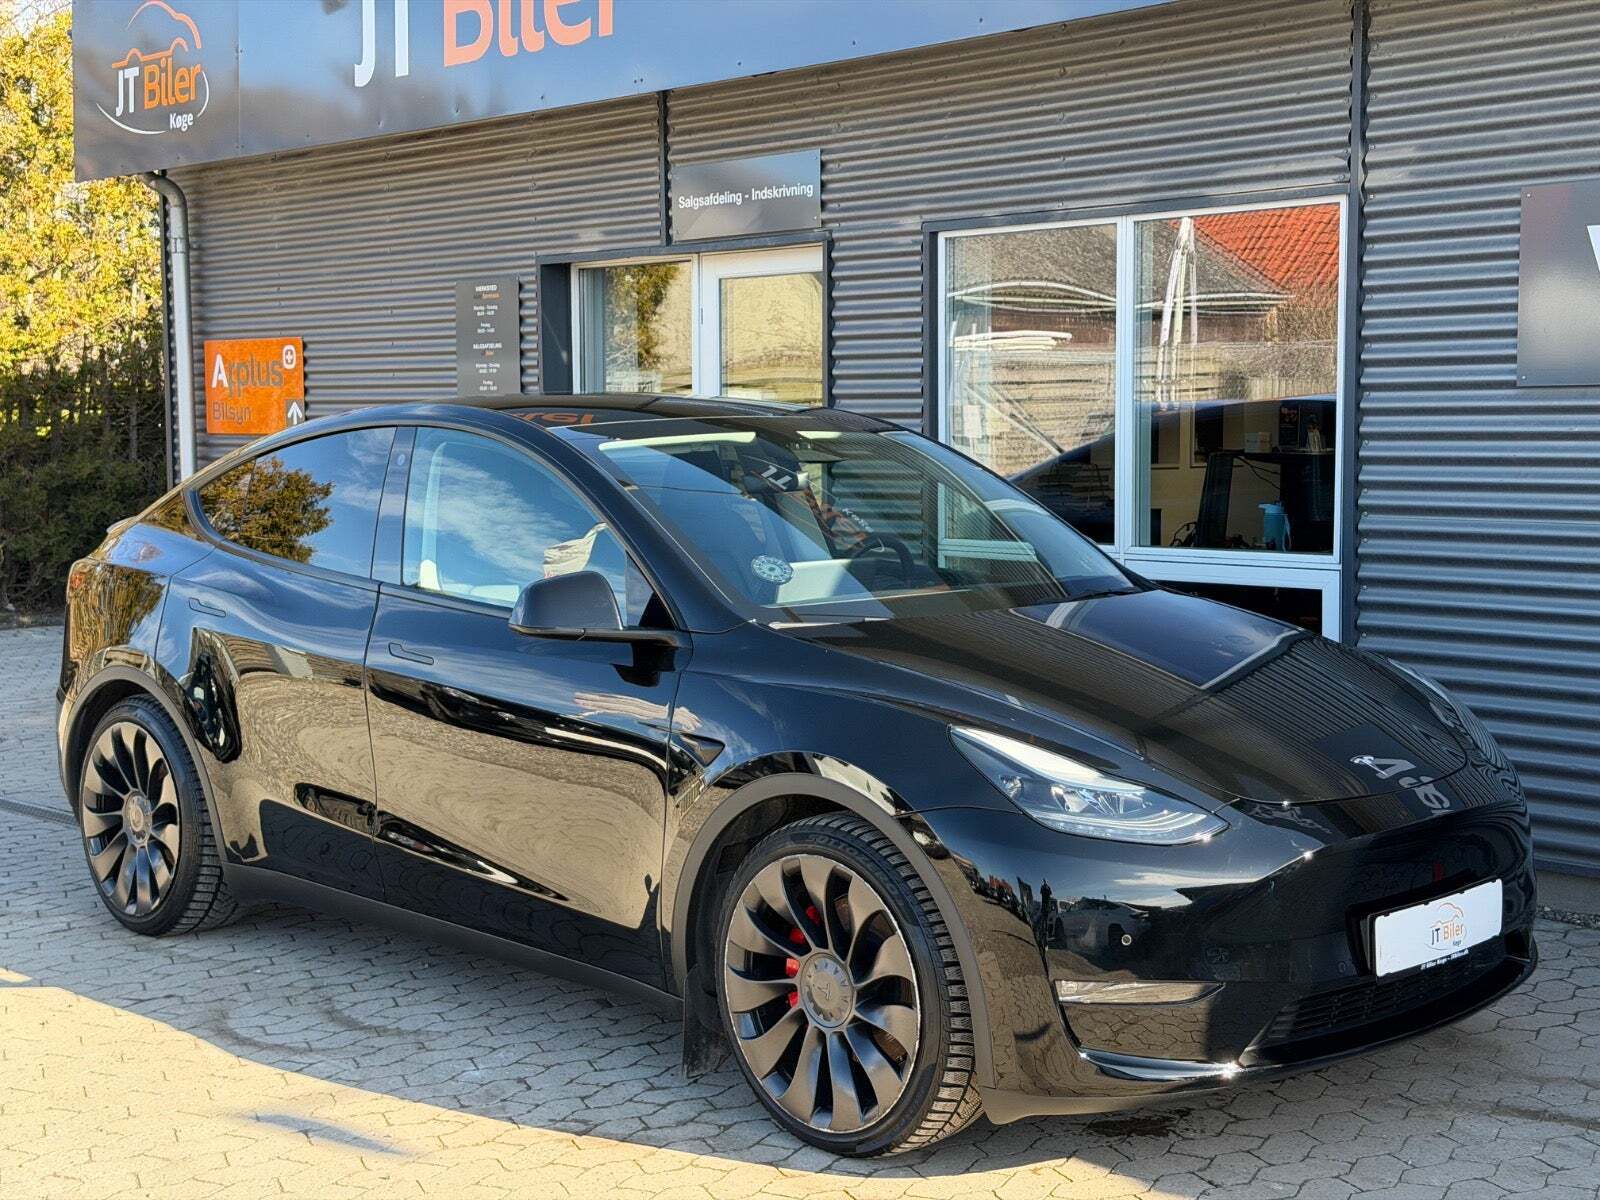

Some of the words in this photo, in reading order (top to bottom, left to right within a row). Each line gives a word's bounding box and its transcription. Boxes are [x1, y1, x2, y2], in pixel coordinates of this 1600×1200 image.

[115, 66, 140, 117] JT
[143, 57, 202, 110] Biler
[169, 112, 194, 132] Køge
[678, 190, 743, 210] Salgsafdeling
[751, 182, 814, 201] Indskrivning
[212, 401, 252, 425] Bilsyn
[1431, 927, 1441, 946] JT
[1443, 924, 1464, 940] Biler
